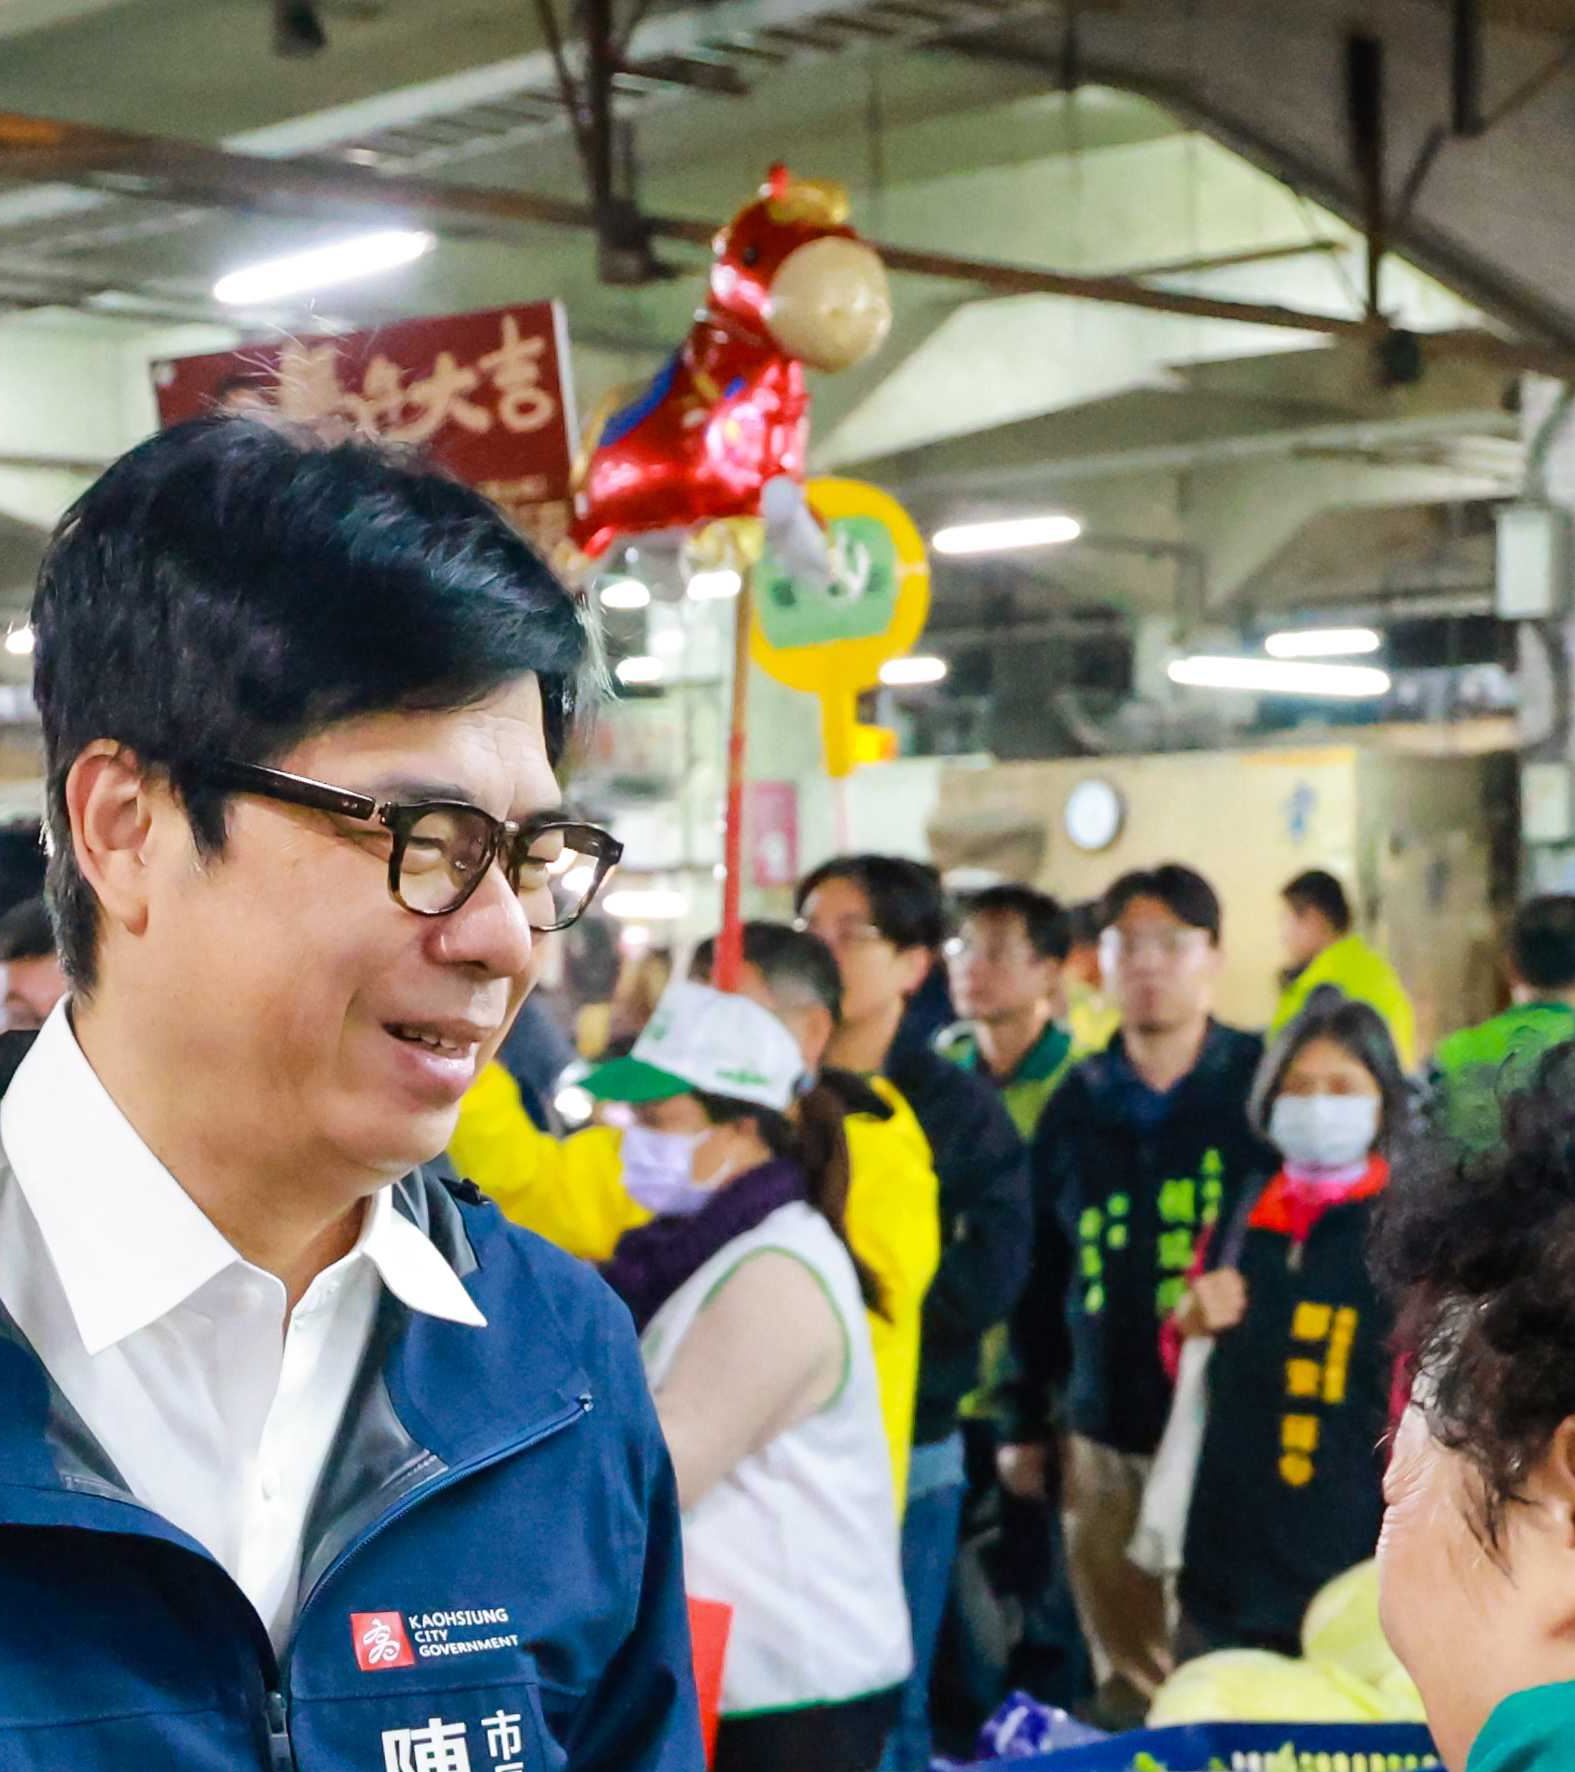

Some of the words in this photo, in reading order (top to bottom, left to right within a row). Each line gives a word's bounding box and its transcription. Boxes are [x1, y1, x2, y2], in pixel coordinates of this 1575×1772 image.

[408, 1608, 509, 1630] KAOHSIUNG
[414, 1629, 449, 1644] CITY
[419, 1634, 519, 1657] GOVERNMENT
